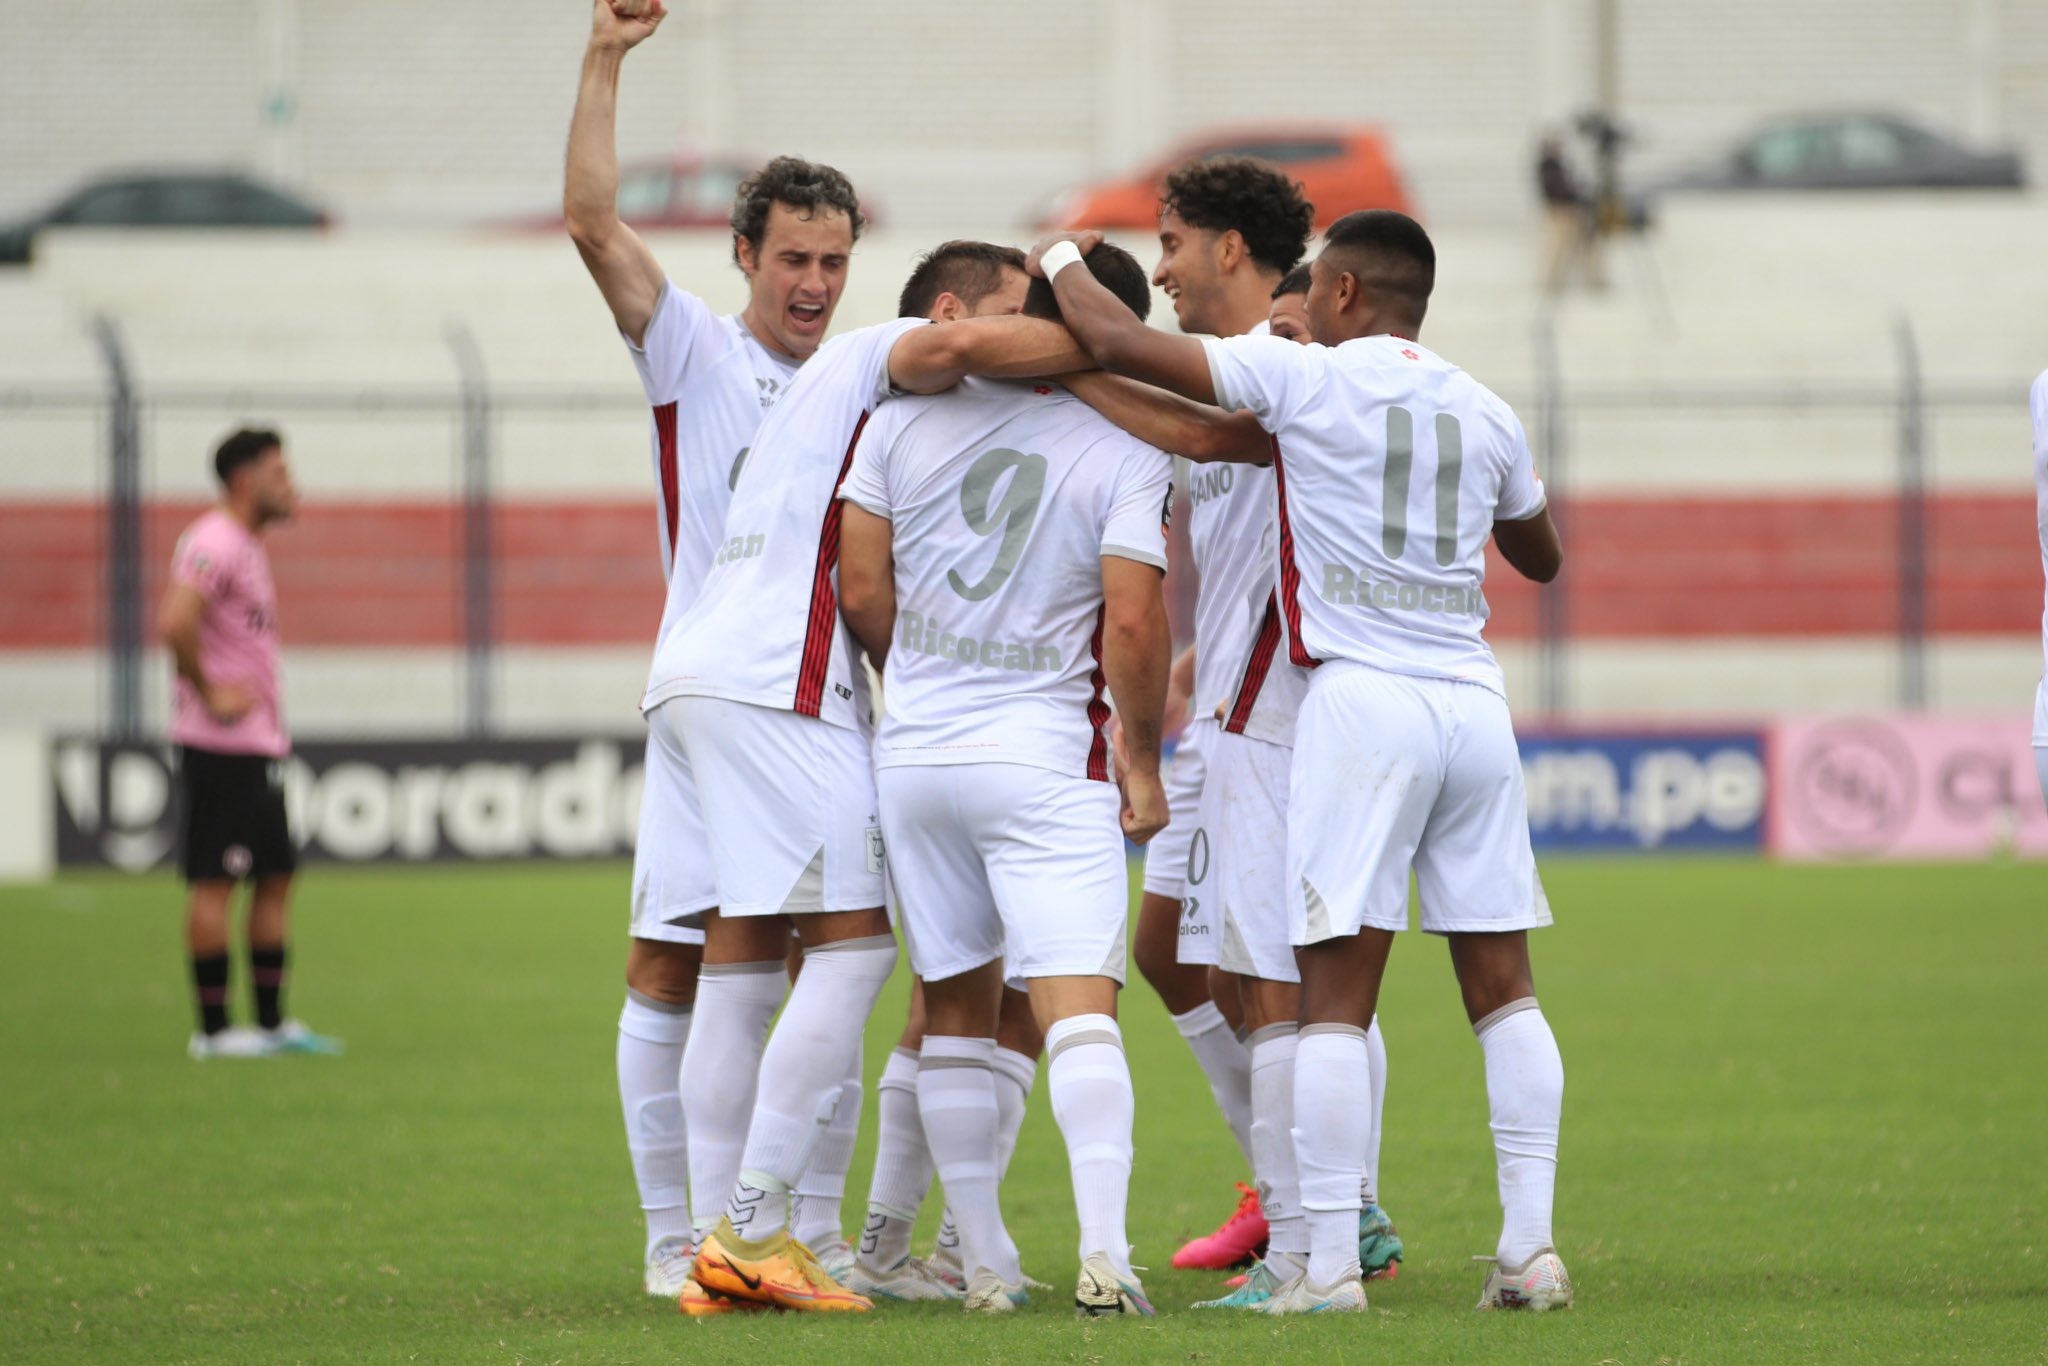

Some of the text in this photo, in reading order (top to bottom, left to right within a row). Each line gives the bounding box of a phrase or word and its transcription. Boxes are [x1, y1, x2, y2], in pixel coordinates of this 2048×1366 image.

[1191, 464, 1234, 507] ANO
[1382, 406, 1463, 567] 11
[948, 448, 1048, 602] 9
[1322, 563, 1486, 615] Ricocan
[901, 610, 1063, 672] Ricocan
[286, 742, 645, 857] orad
[1187, 827, 1210, 886] 0
